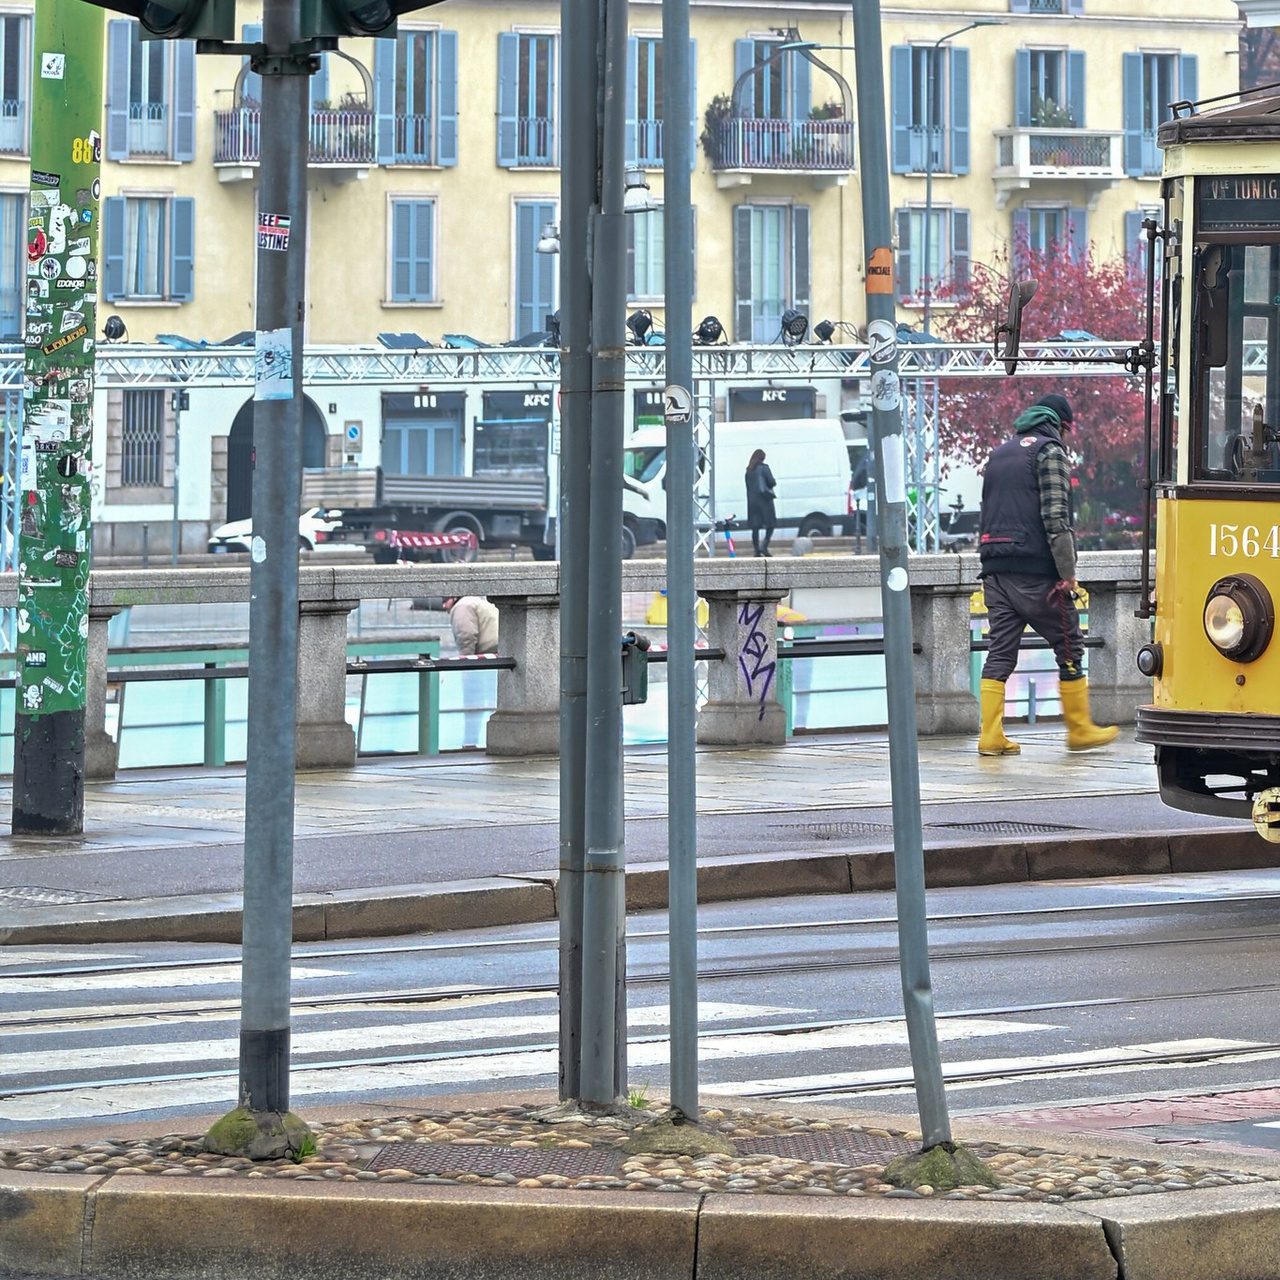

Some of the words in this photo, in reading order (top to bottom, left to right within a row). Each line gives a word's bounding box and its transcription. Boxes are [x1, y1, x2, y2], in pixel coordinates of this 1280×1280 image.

[72, 137, 92, 164] 88
[523, 393, 550, 406] KFC
[762, 390, 787, 402] KFC
[1209, 524, 1280, 558] 1564
